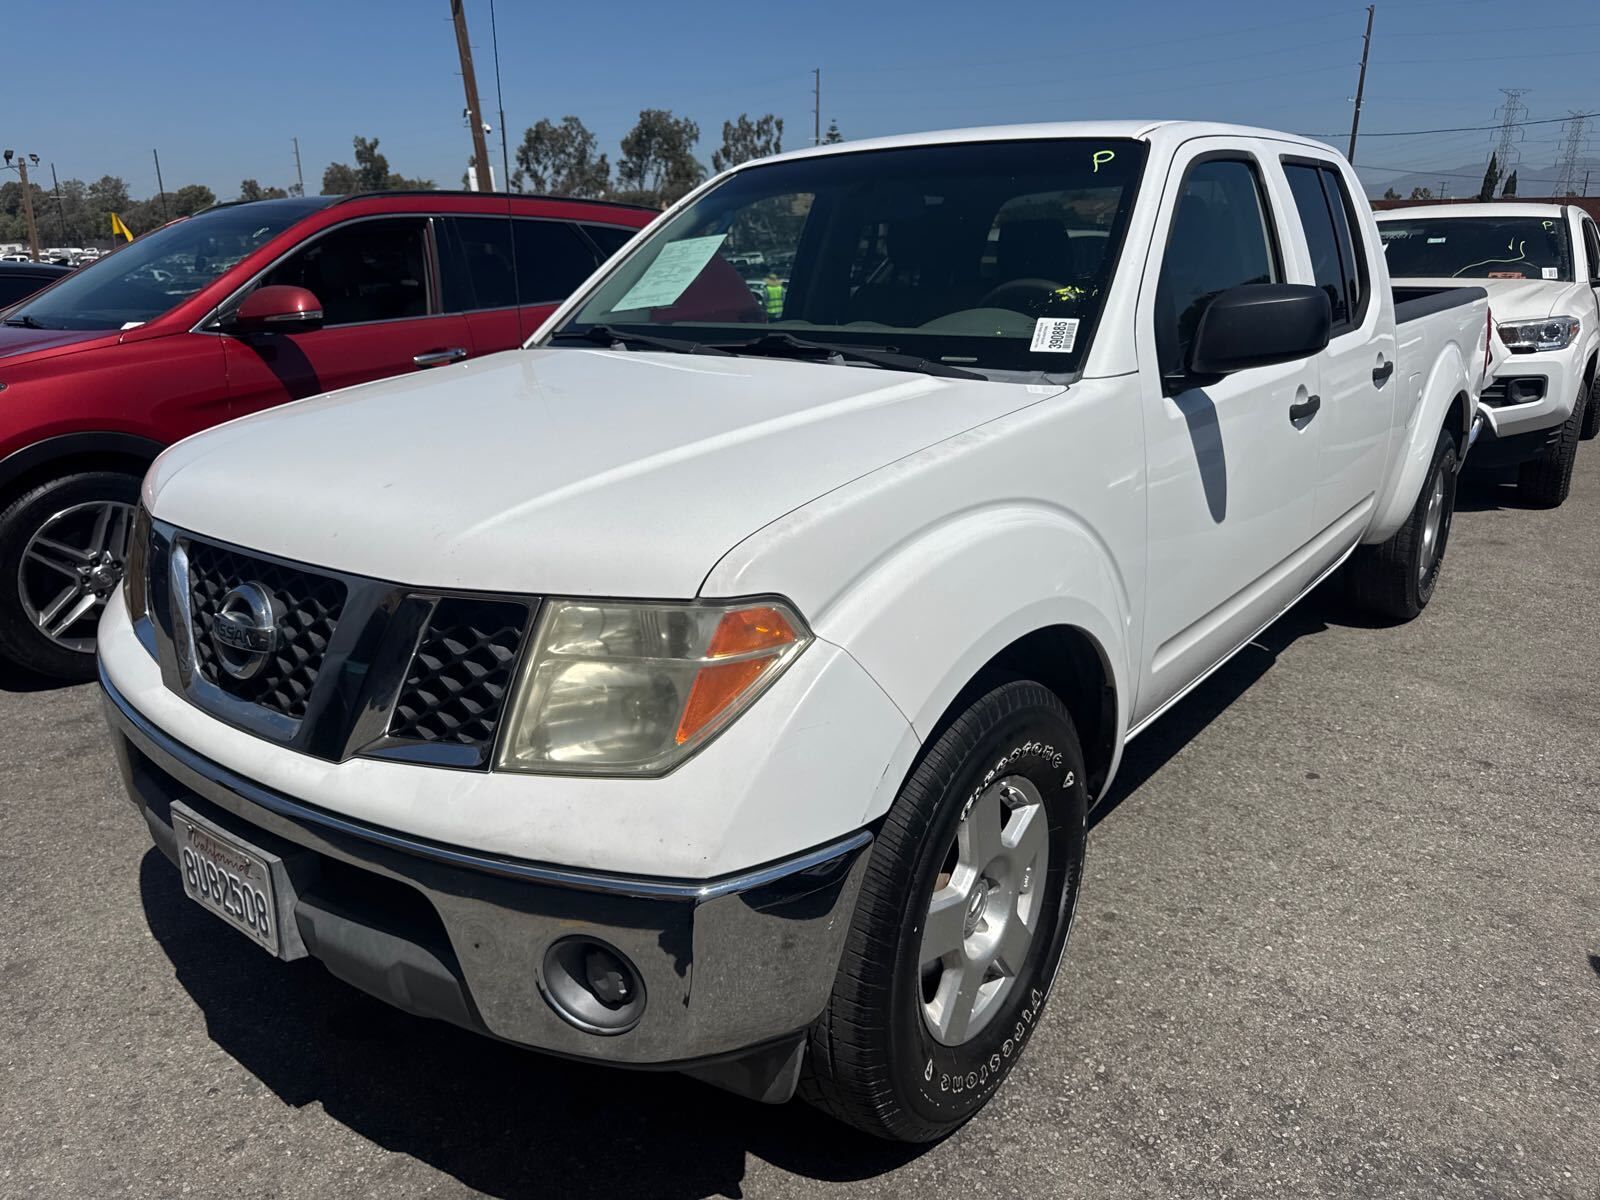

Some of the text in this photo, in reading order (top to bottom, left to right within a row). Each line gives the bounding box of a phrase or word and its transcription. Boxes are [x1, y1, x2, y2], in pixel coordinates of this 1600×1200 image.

[1093, 150, 1115, 173] P
[1048, 321, 1068, 349] 390885
[183, 846, 270, 938] 8U82508
[940, 988, 1044, 1094] Firestone
